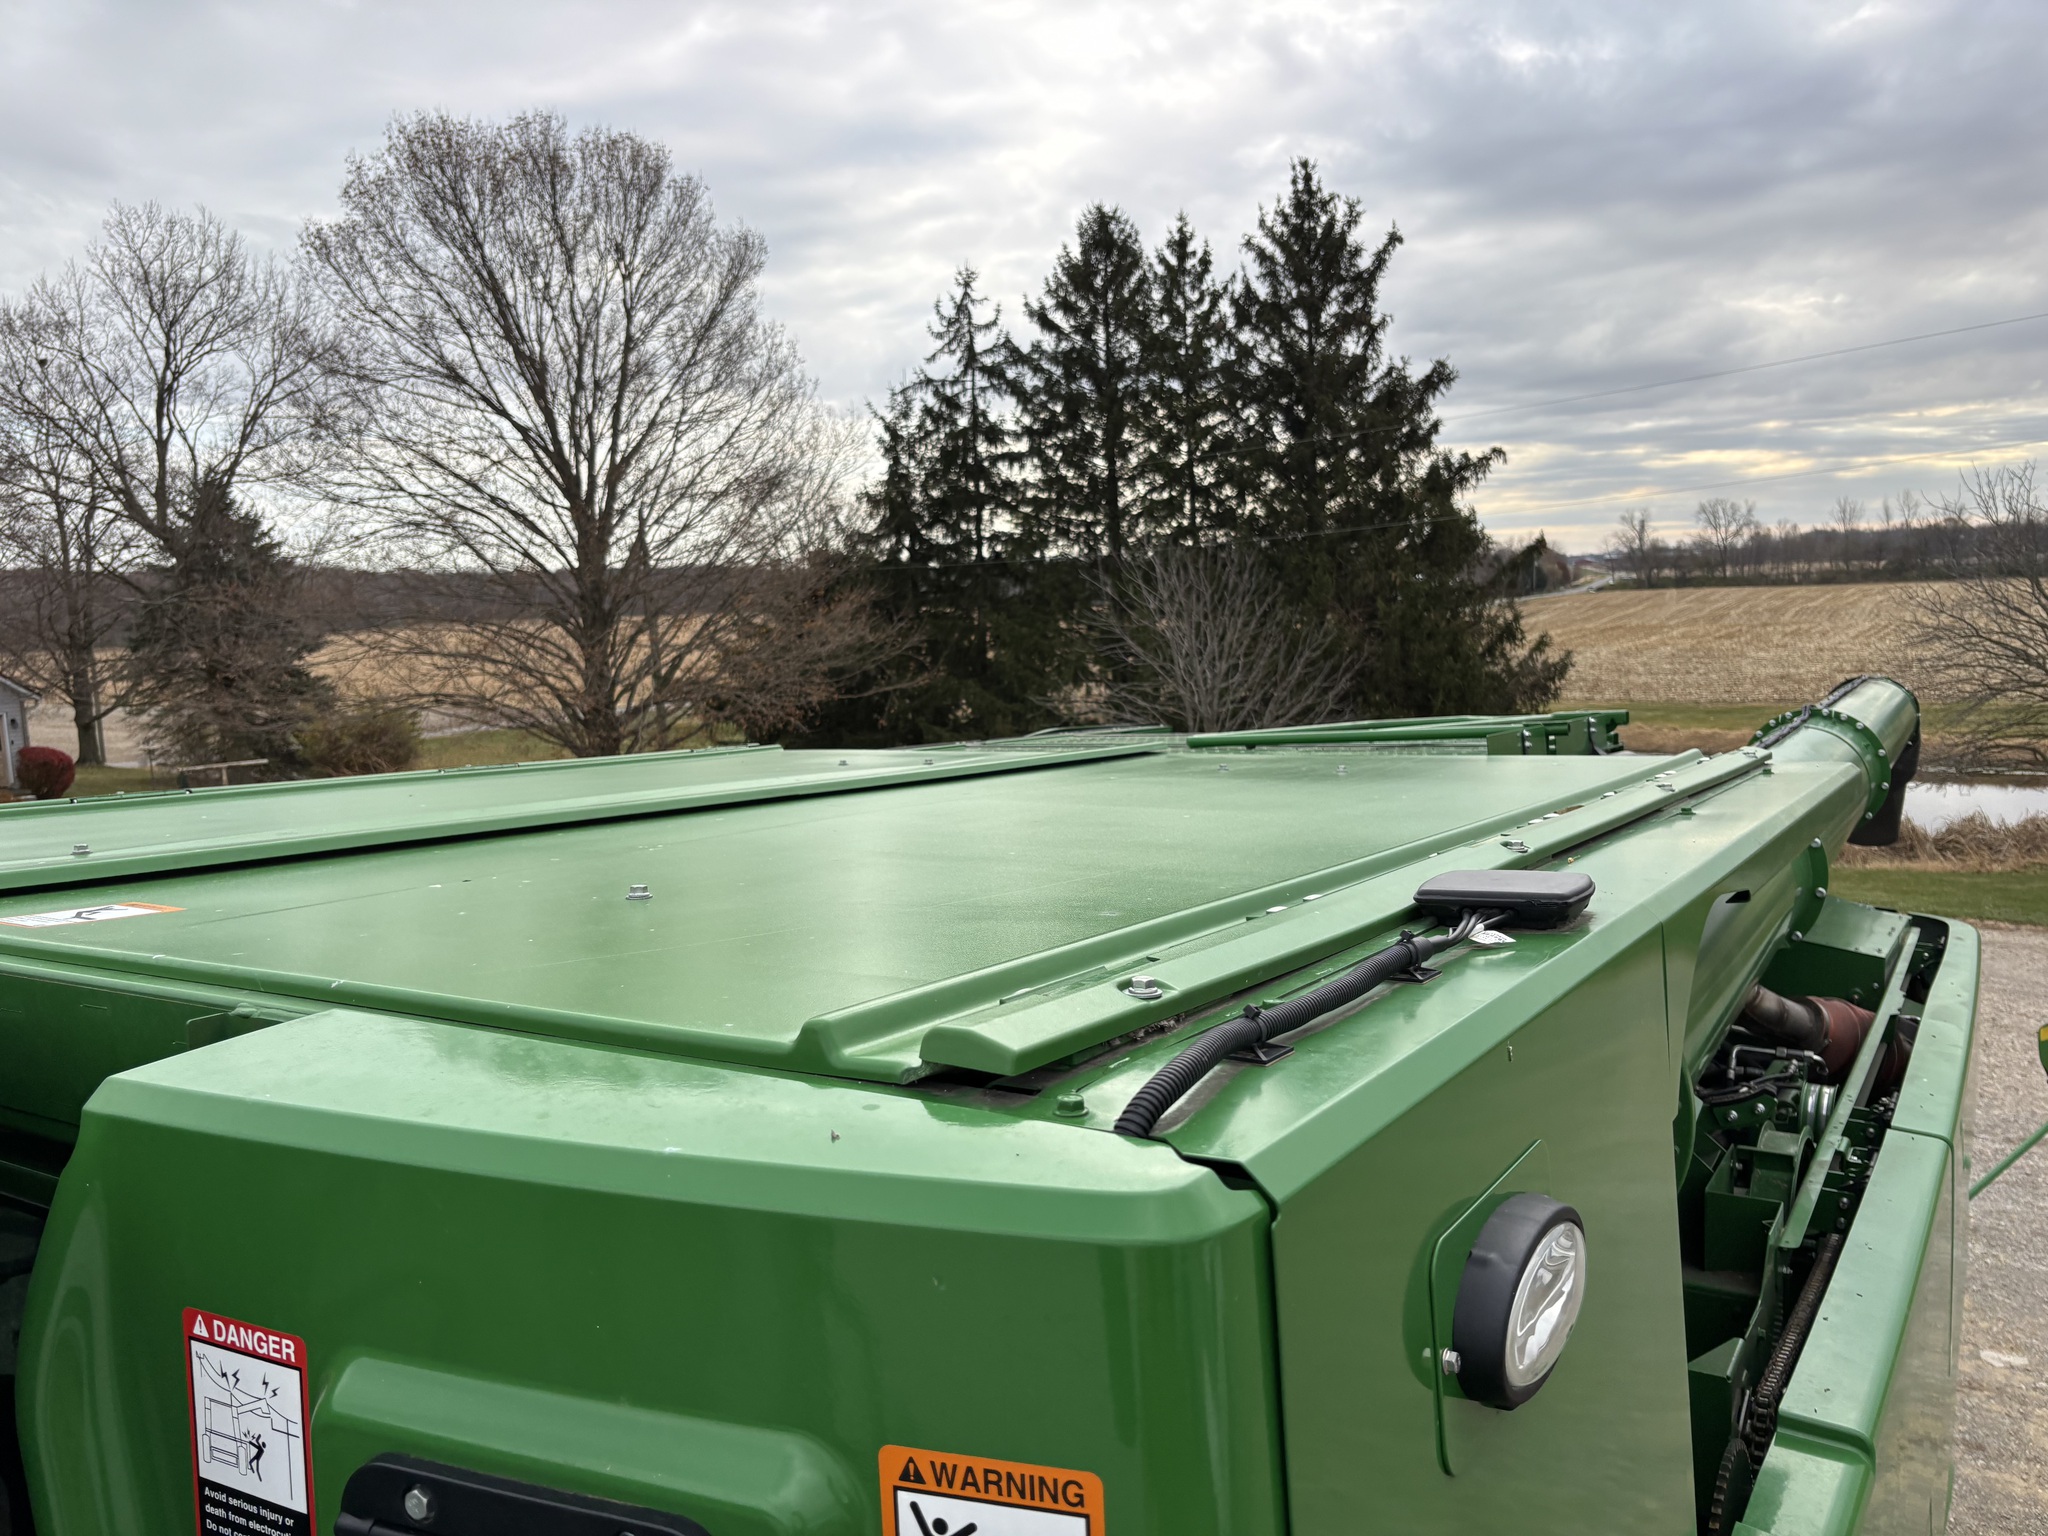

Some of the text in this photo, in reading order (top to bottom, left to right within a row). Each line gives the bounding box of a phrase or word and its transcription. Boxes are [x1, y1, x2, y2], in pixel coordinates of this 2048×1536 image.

[213, 1320, 295, 1362] DANGER
[930, 1460, 1085, 1508] WARNING
[205, 1487, 294, 1526] Avoid serious injury or
[205, 1504, 226, 1518] death
[228, 1511, 247, 1526] from
[248, 1520, 292, 1536] electrocu
[206, 1519, 217, 1531] Do
[219, 1526, 232, 1536] not
